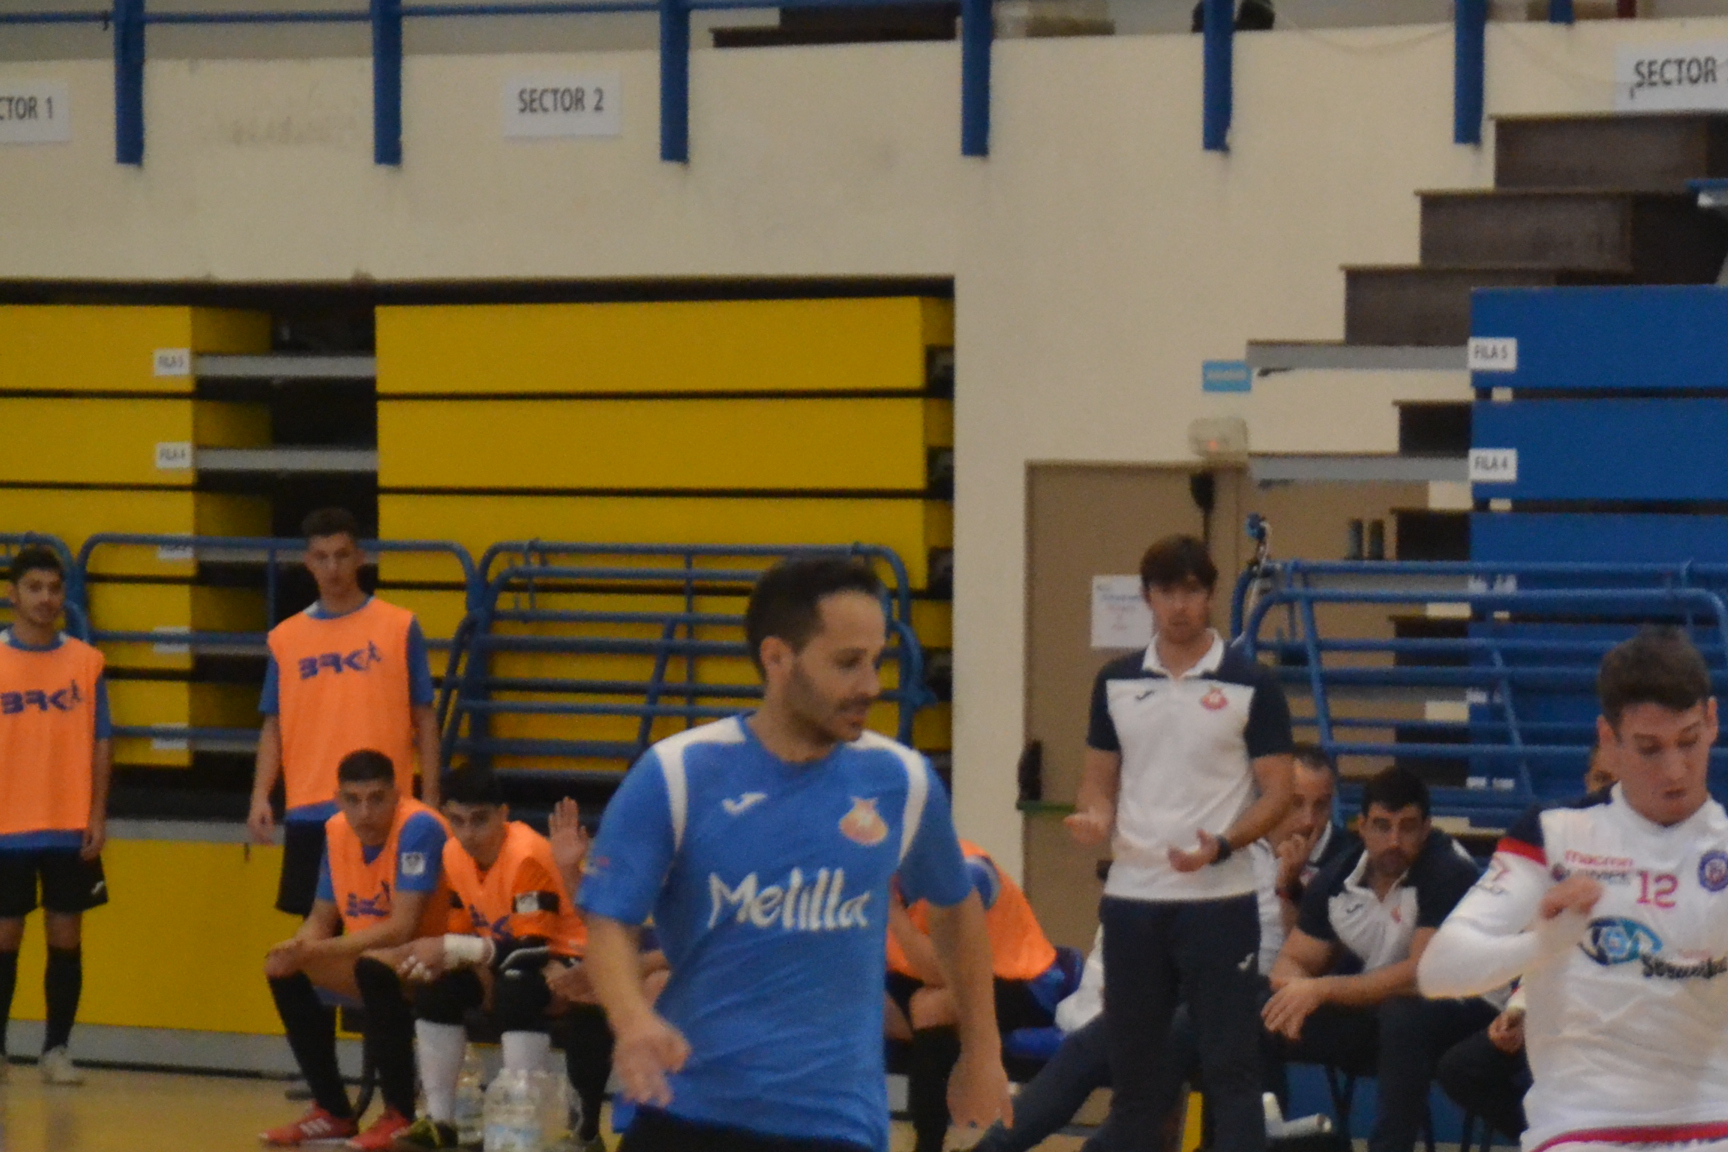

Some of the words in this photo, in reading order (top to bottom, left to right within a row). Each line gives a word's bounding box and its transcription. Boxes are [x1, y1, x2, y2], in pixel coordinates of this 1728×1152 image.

[1634, 56, 1717, 88] SECTOR
[46, 95, 53, 119] 1
[519, 86, 585, 113] SECTOR
[593, 86, 604, 111] 2
[707, 866, 871, 932] Melilla
[1637, 870, 1679, 908] 12
